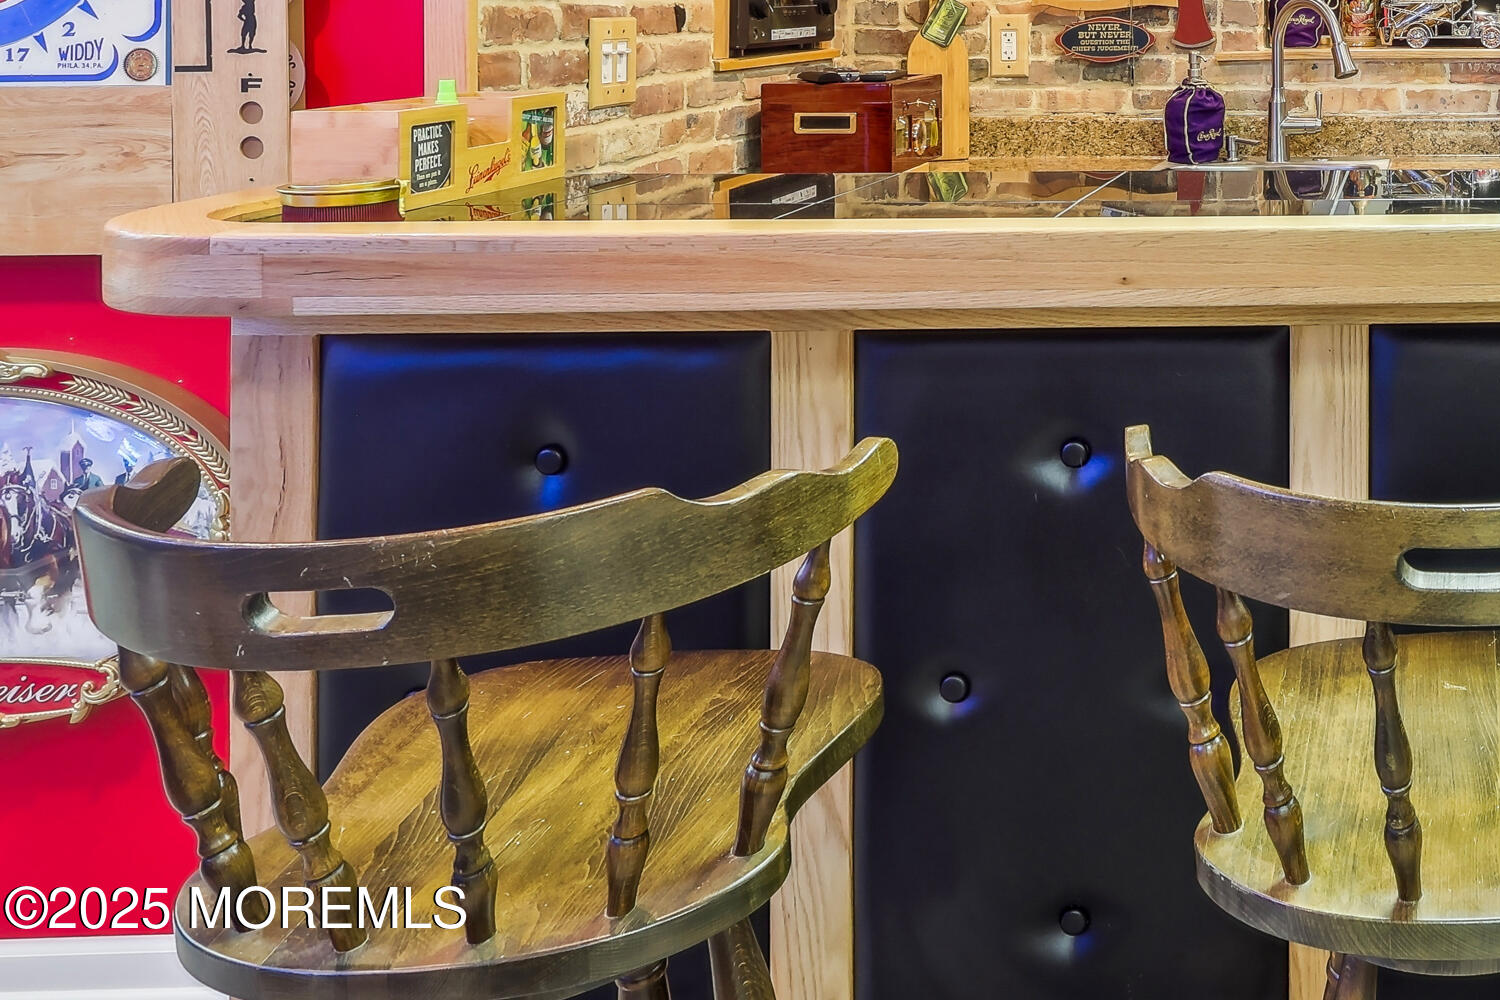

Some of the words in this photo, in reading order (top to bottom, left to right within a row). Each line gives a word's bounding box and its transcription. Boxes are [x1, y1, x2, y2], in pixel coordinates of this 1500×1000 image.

[61, 21, 76, 37] 2
[1078, 31, 1098, 39] BUT
[1100, 31, 1132, 39] NEVER
[5, 48, 29, 62] 17
[58, 37, 105, 62] WIDDY
[241, 78, 262, 92] F
[413, 125, 443, 143] PRACTICE
[418, 141, 439, 157] MAKES
[415, 154, 442, 173] PERFECT.
